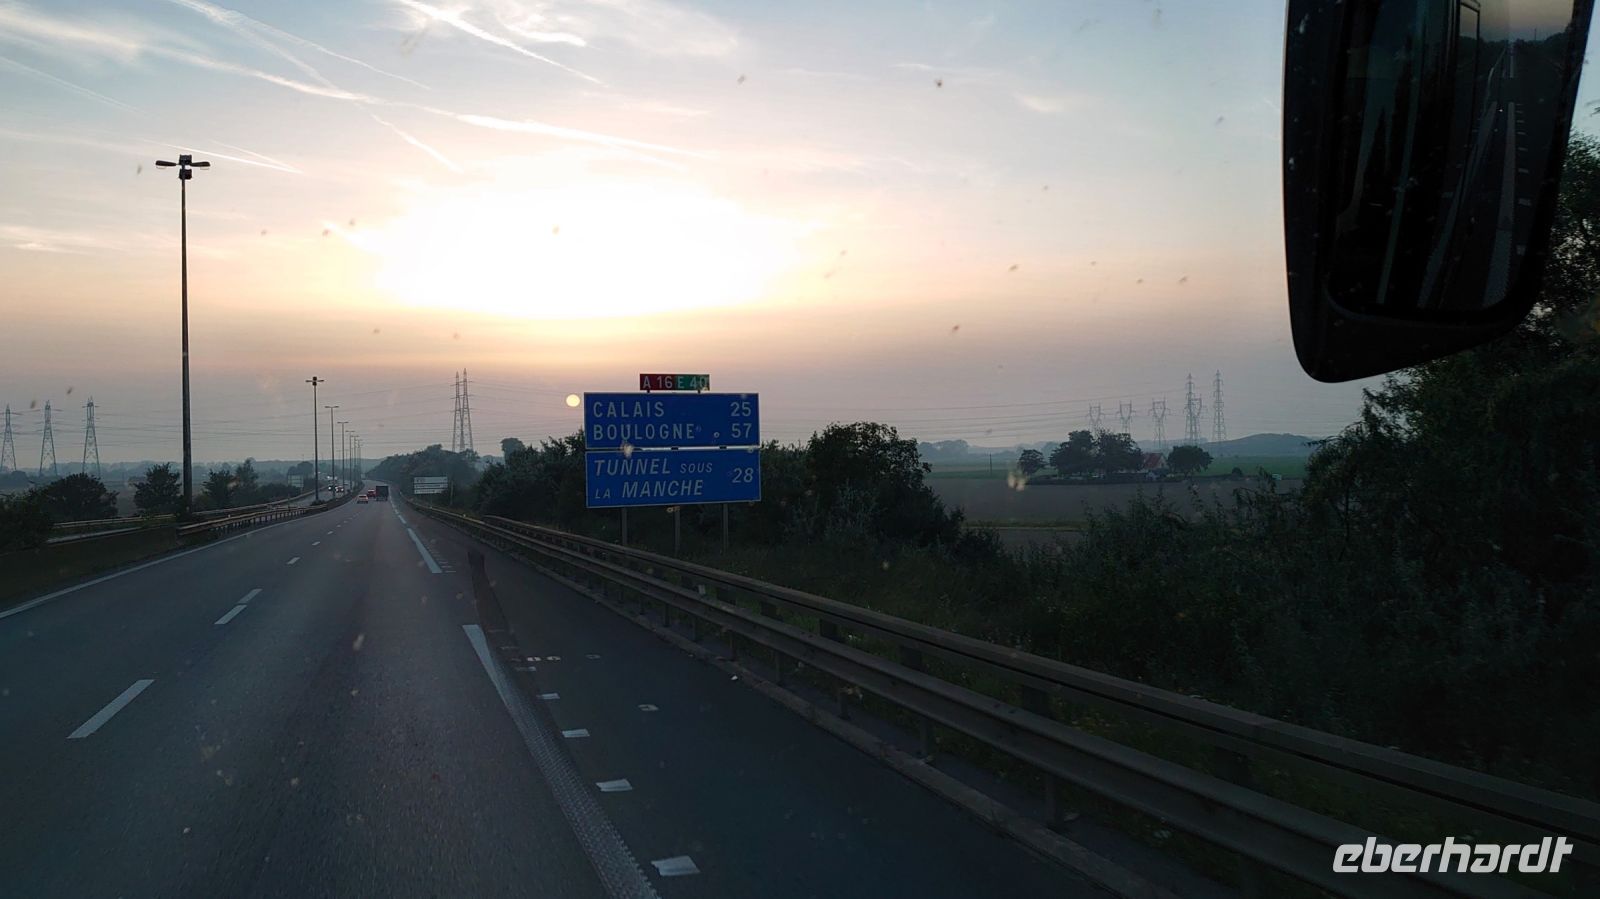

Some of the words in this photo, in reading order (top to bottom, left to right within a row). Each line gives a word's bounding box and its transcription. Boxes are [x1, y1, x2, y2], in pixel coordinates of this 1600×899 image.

[643, 377, 650, 388] A
[657, 377, 672, 388] 16
[677, 377, 684, 388] E
[690, 377, 707, 389] 40
[593, 402, 664, 418] CALAIS
[730, 402, 751, 417] 25
[594, 424, 695, 440] BOULOGNE
[731, 423, 752, 438] 57
[594, 459, 671, 476] TUNNEL
[732, 468, 753, 483] 28
[595, 489, 610, 499] LA
[622, 480, 703, 498] MANCHE
